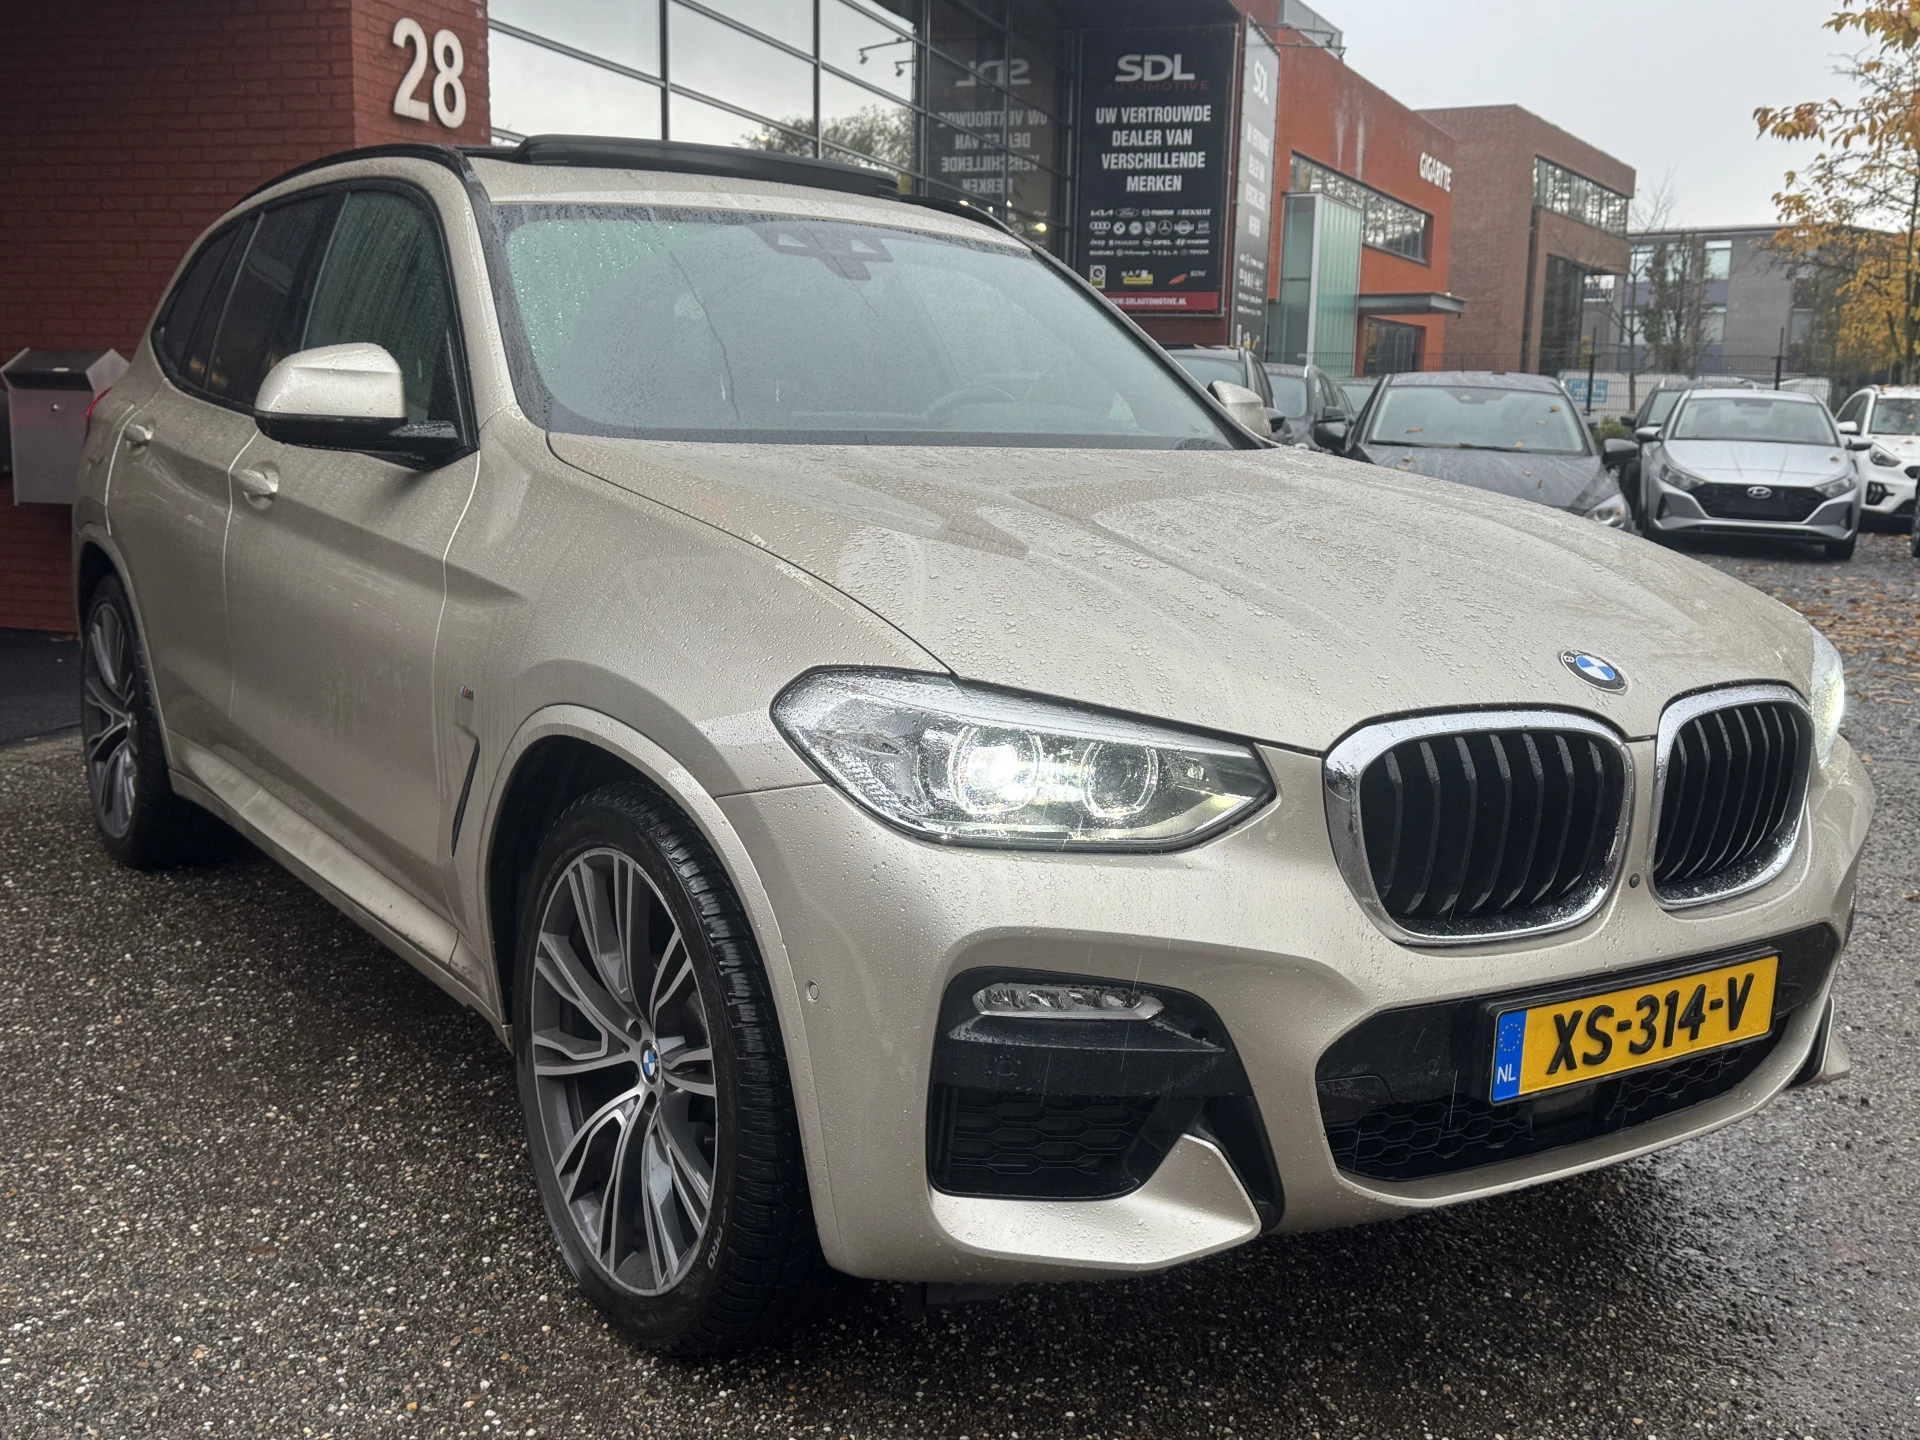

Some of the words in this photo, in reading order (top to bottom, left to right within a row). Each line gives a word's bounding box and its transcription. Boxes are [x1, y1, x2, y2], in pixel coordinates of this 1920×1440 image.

[392, 17, 467, 129] 28
[1114, 53, 1196, 82] SDL
[1103, 80, 1209, 92] AUTOMOTIVE
[1095, 107, 1118, 124] UW
[1121, 104, 1212, 123] VERTROUWDE
[1112, 130, 1162, 147] DEALER
[1166, 128, 1193, 146] VAN
[1101, 151, 1206, 170] VERSCHILLENDE
[1126, 174, 1183, 193] MERKEN
[1546, 972, 1755, 1075] XS-314-V
[1496, 1064, 1516, 1085] NL
